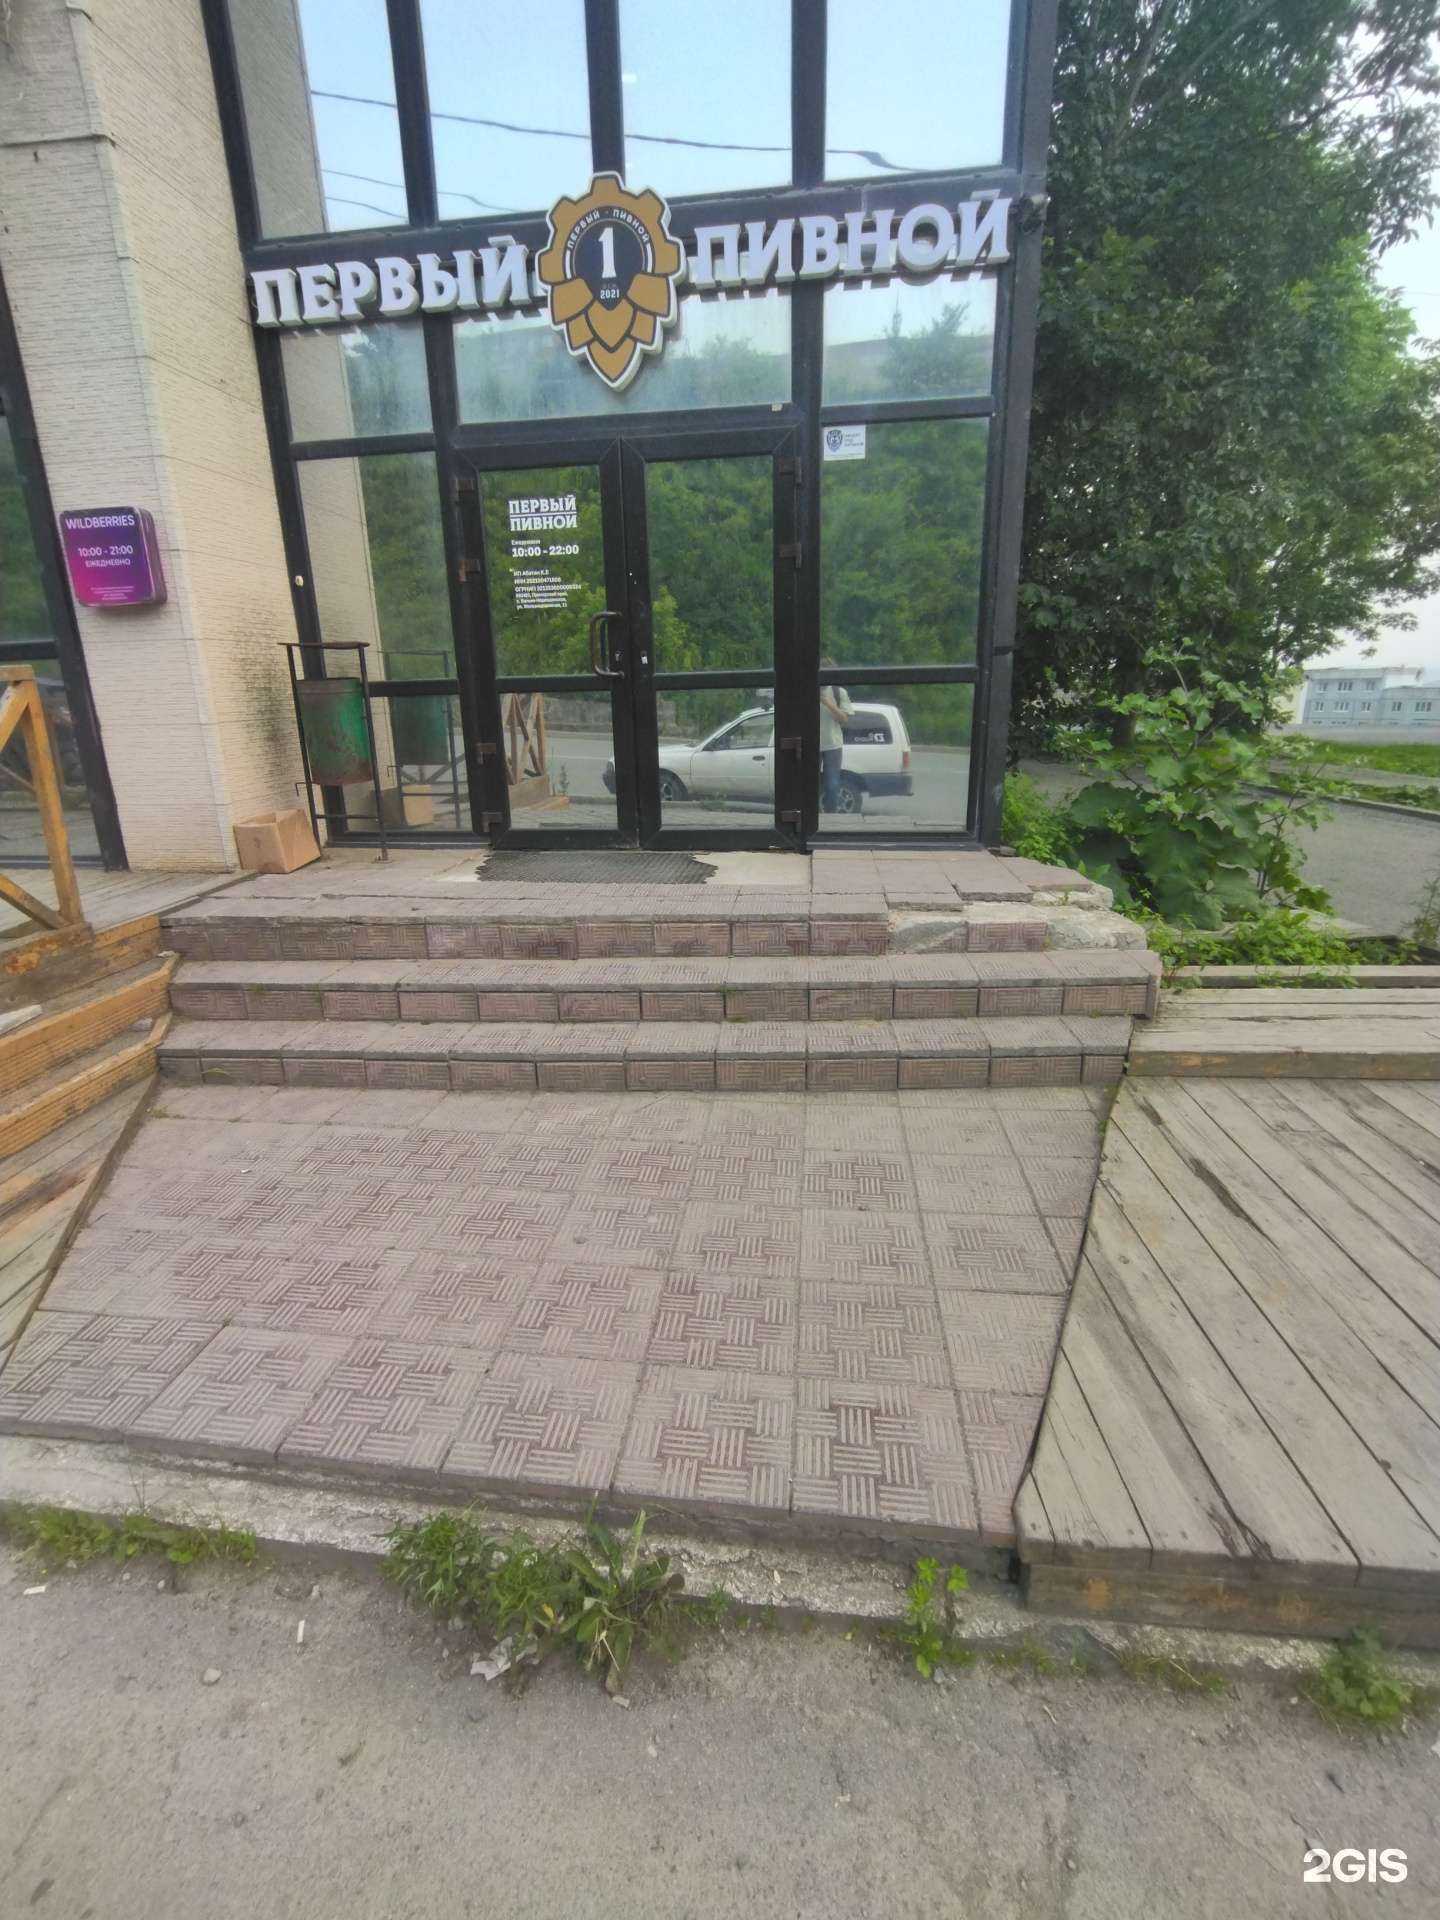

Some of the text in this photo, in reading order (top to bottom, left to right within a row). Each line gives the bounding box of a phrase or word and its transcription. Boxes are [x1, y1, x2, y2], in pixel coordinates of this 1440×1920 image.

[567, 209, 650, 248] ПЕРВЫЙ ПИВНОЙ
[251, 189, 1013, 328] ПЕРВЫЙ ПИВНОЙ
[598, 227, 617, 279] 1
[600, 289, 620, 299] 2021
[508, 494, 577, 514] ПЕРВЫЙ
[65, 515, 136, 529] WILDBERRIES
[510, 515, 578, 531] ПИВНОЙ
[78, 547, 103, 557] 10:00
[109, 545, 134, 555] 21:00
[512, 546, 541, 558] 10:00
[549, 544, 579, 556] 22:00
